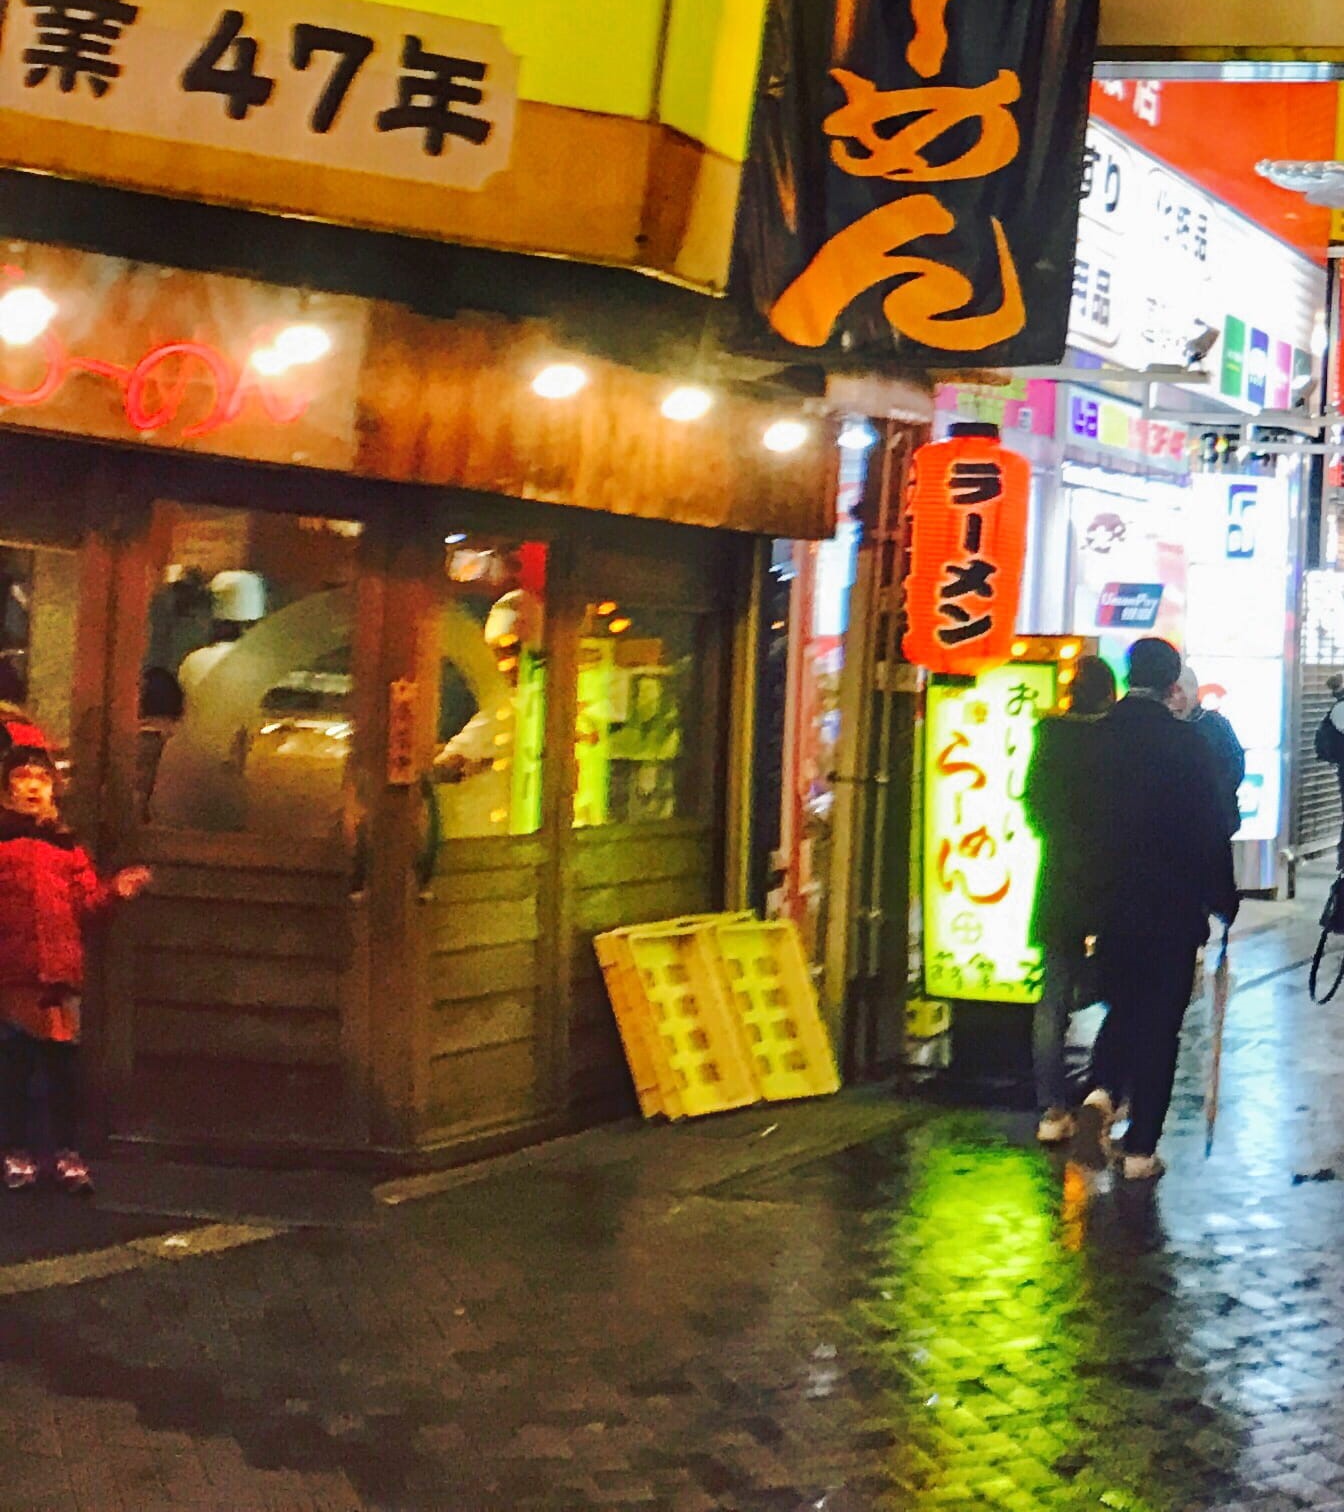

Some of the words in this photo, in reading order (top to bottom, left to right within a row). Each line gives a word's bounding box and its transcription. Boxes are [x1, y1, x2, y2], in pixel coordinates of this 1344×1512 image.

[936, 462, 1004, 647] ラーメン
[936, 729, 1011, 905] らーめん
